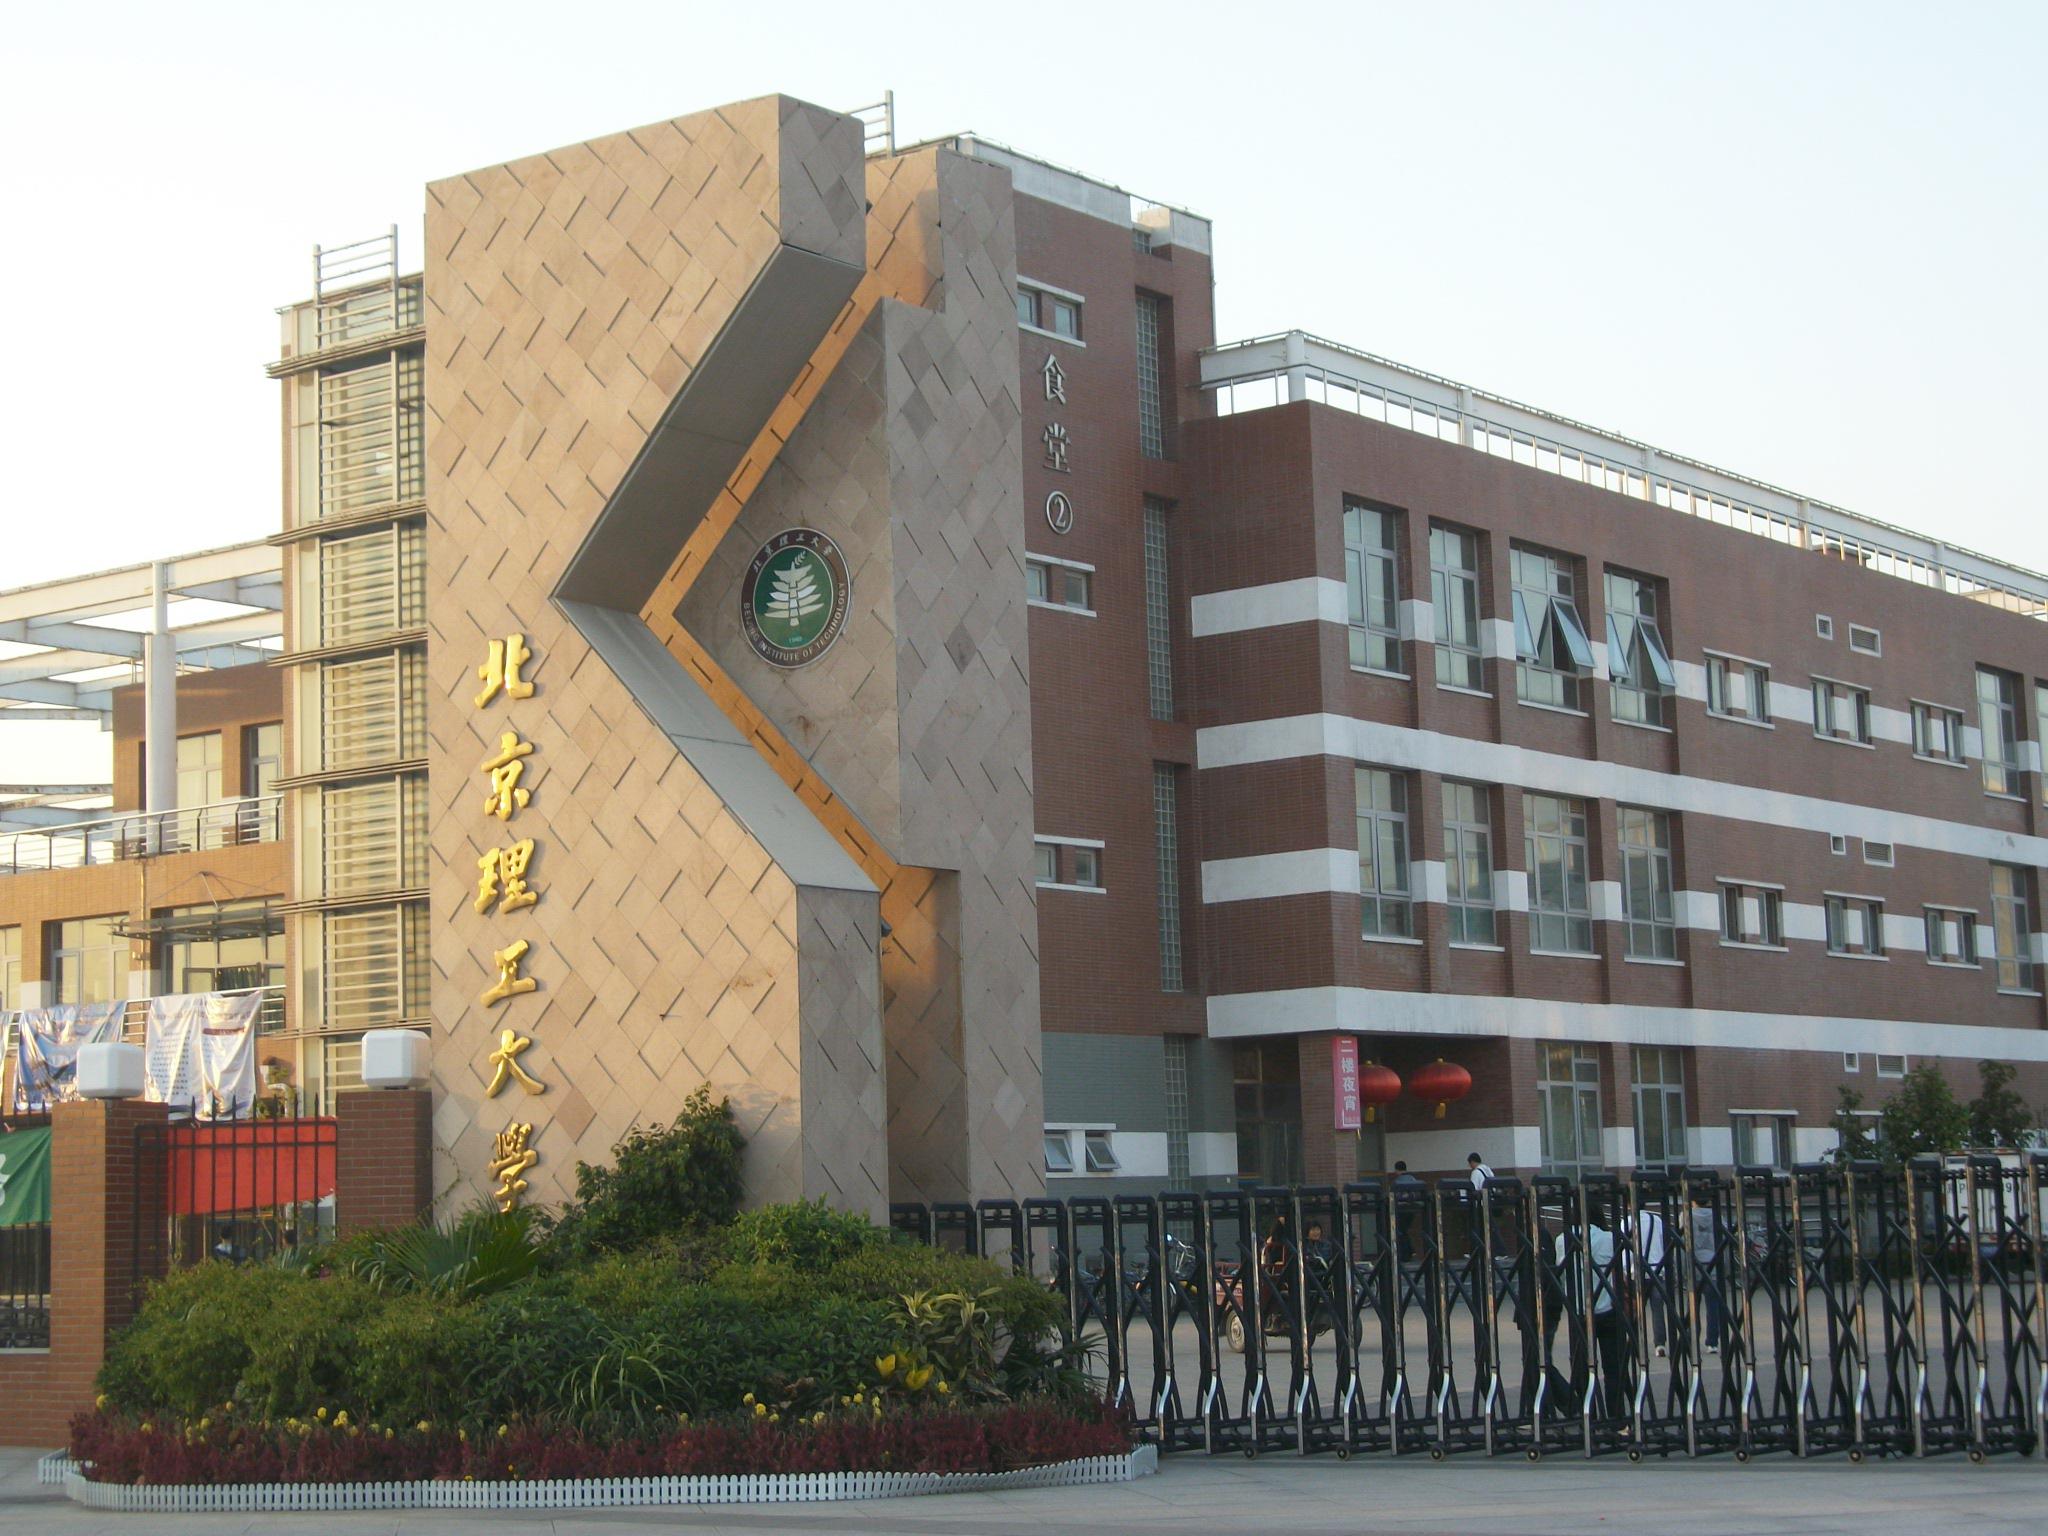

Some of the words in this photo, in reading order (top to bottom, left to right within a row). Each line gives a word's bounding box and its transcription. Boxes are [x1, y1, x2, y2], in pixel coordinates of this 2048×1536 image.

[758, 641, 800, 661] INSTITUTE
[802, 647, 814, 658] OF
[816, 582, 845, 649] TECHNOLOGY
